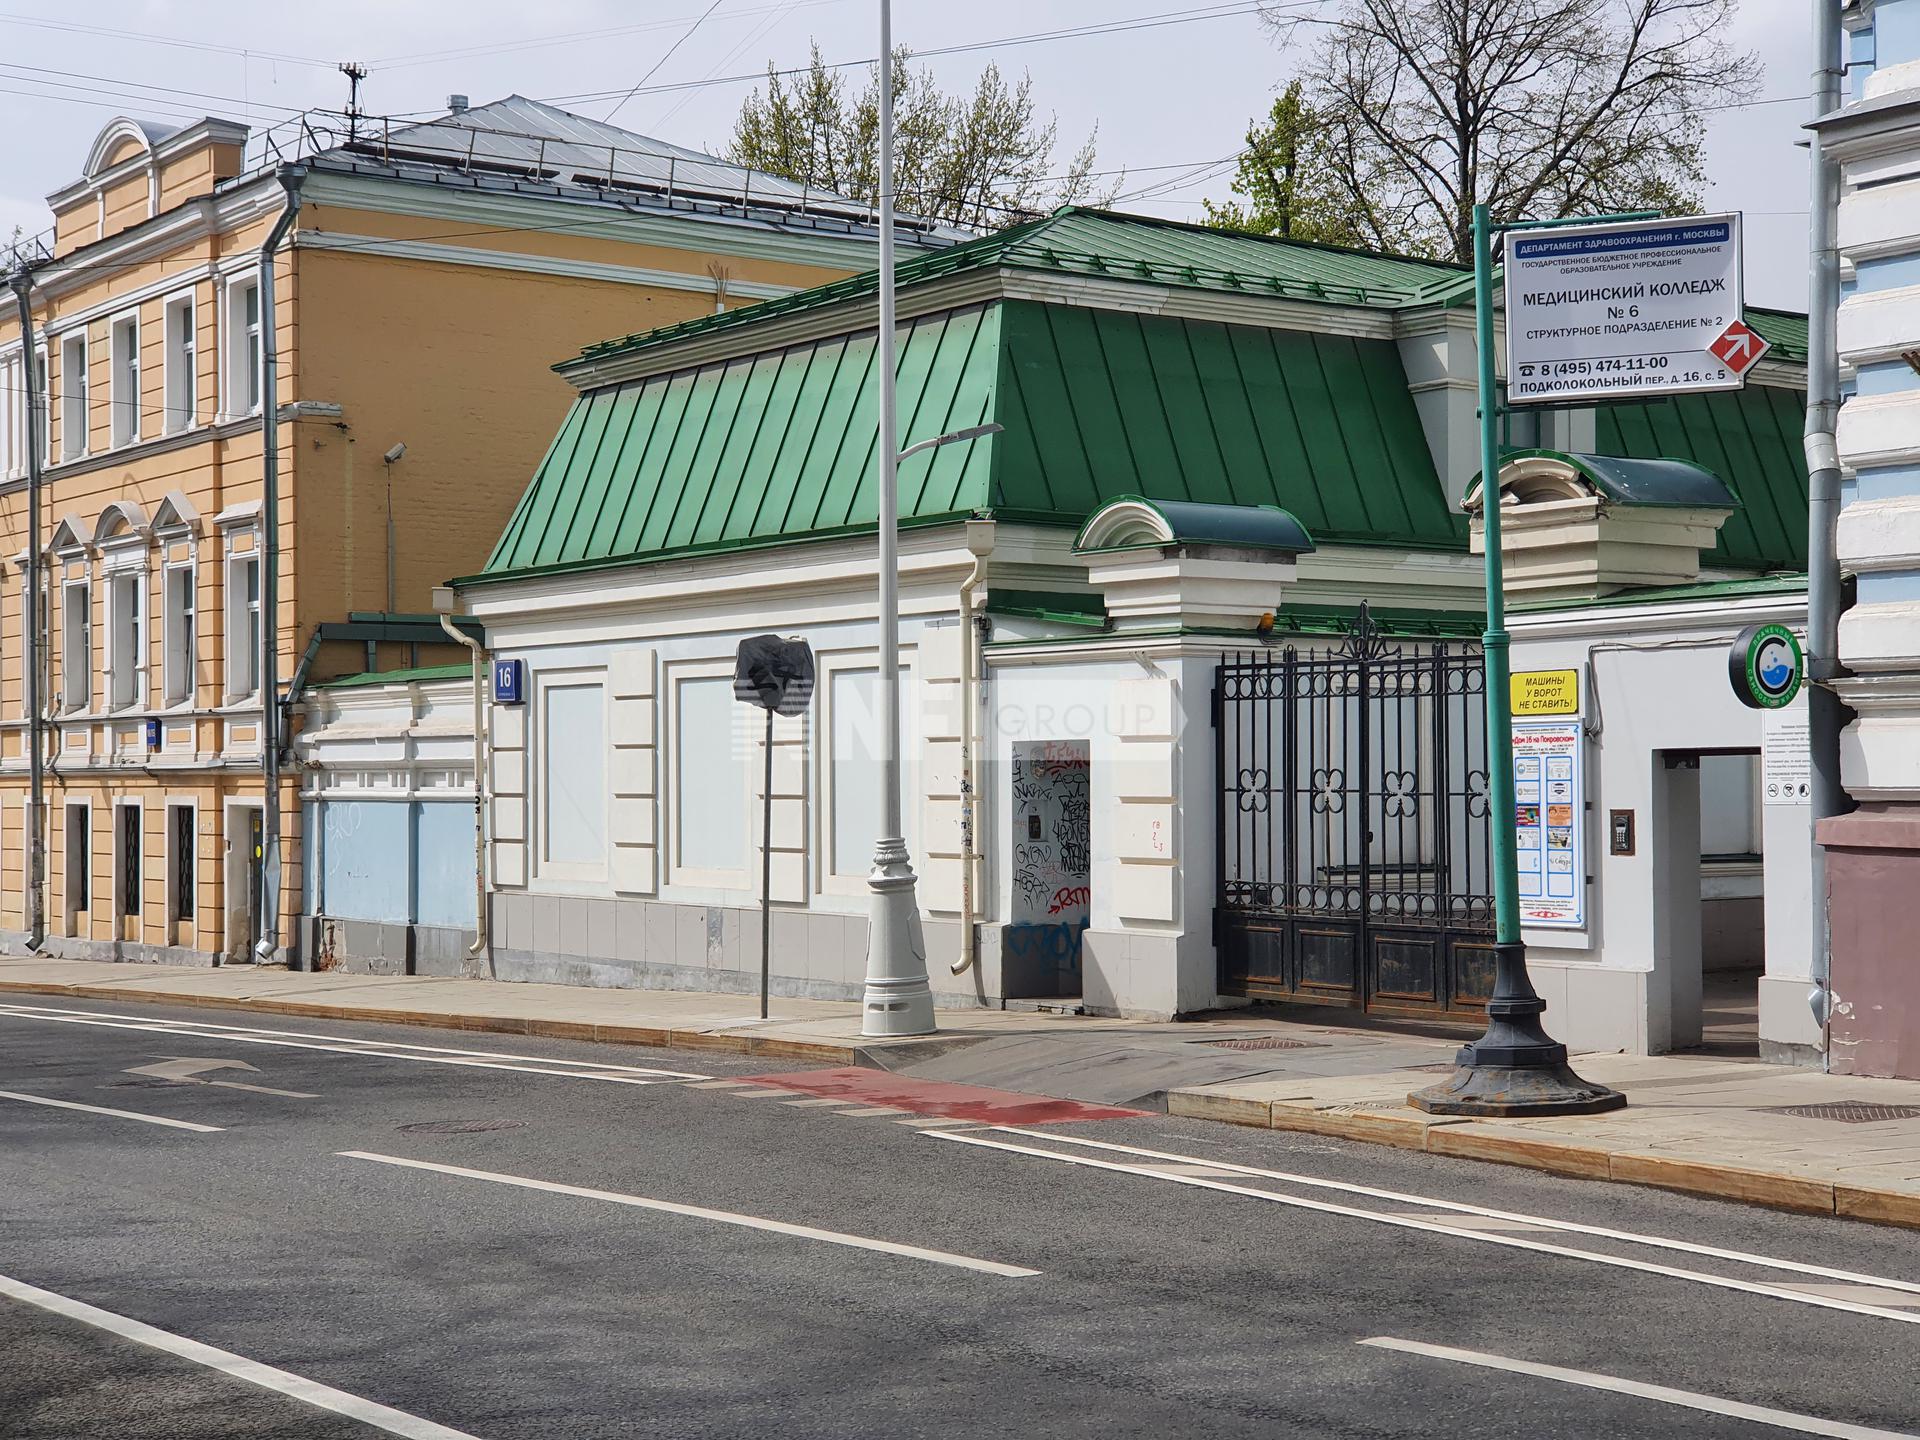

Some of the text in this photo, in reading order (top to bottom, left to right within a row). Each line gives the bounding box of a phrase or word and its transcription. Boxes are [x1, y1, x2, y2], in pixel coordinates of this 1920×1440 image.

[1520, 241, 1583, 254] ДЕПАРТАМЕНТ
[1584, 233, 1673, 249] ЗДРАВООХРАНЕНИЯ
[1683, 228, 1725, 240] МОСКВЫ
[1521, 245, 1722, 269] ГОСУДАРСТВЕННОЕ БЮДЖЕТНОЕ ПРОФЕССИОНАЛЬНОЕ
[1560, 258, 1682, 275] ОБРАЗОВАТЕЛЬНОЕ УЧРЕЖДЕНИЕ
[1523, 278, 1726, 307] МЕДИЦИНСКИЙ КОЛЛЕДЖ
[1607, 304, 1639, 320] № 6
[1526, 316, 1723, 340] СТРУКТУРНОЕ ПОДРАЗДЕЛЕНИЕ № 2
[1541, 356, 1669, 377] 8 (495) 474-11-00
[1520, 373, 1643, 394] ПОДКОЛОКОЛЬНЫЙ
[1717, 369, 1726, 380] 5
[498, 667, 511, 688] 16
[1525, 676, 1566, 686] МАШИНЫ
[1526, 688, 1562, 698] У ВОРОТ
[1519, 699, 1573, 709] НЕ СТАВИТЬ!
